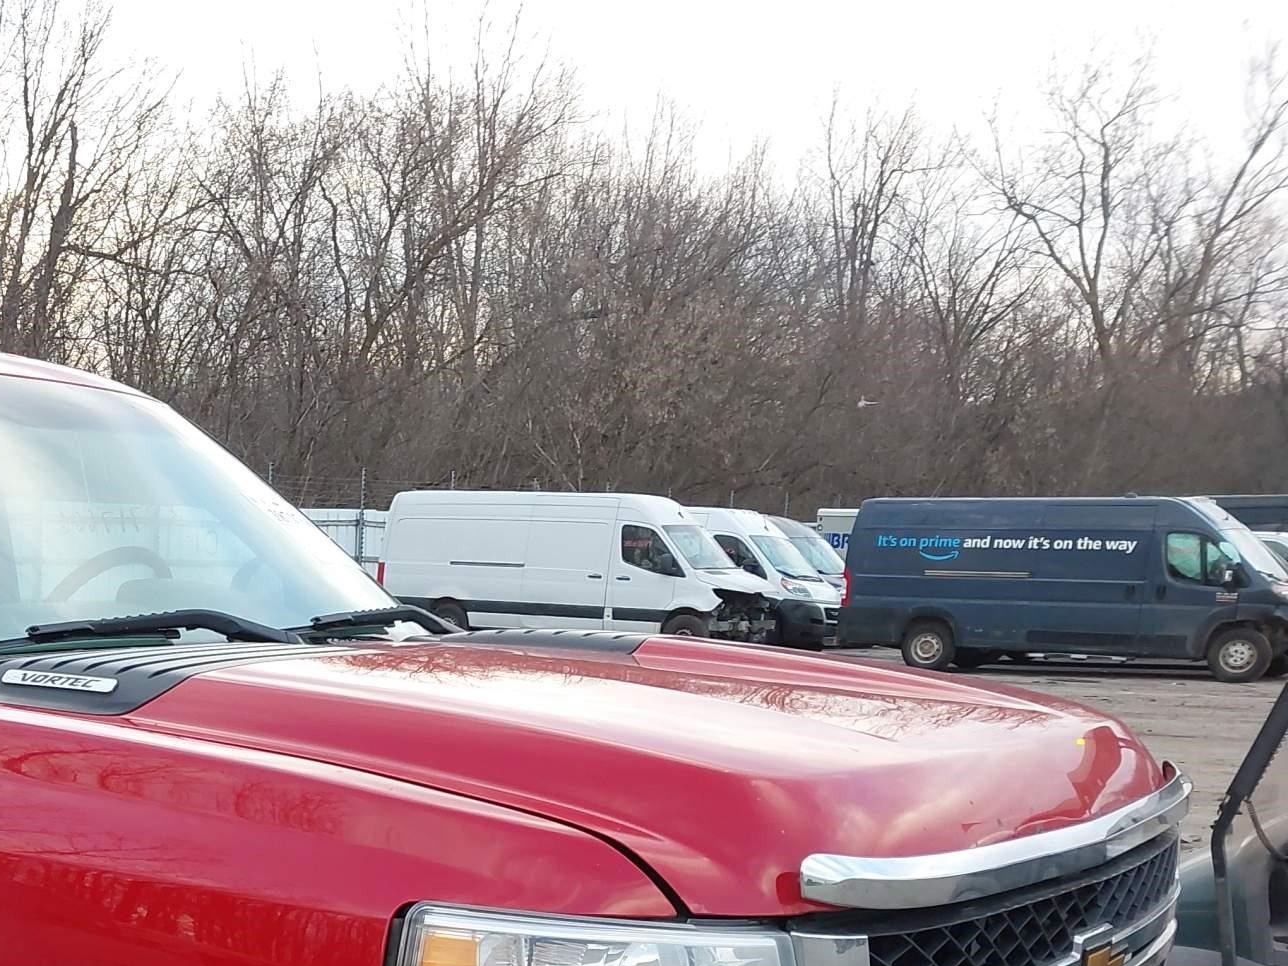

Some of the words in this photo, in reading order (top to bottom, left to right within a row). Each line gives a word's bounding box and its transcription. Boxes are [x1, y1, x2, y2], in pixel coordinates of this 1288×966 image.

[878, 535, 897, 548] It's
[899, 538, 917, 548] on
[918, 535, 961, 550] prime
[962, 536, 992, 549] and
[993, 539, 1026, 550] now
[1027, 536, 1051, 550] it's
[1053, 539, 1073, 550] on
[1076, 536, 1102, 551] the
[1105, 540, 1138, 554] way
[21, 672, 102, 689] VORTEC
